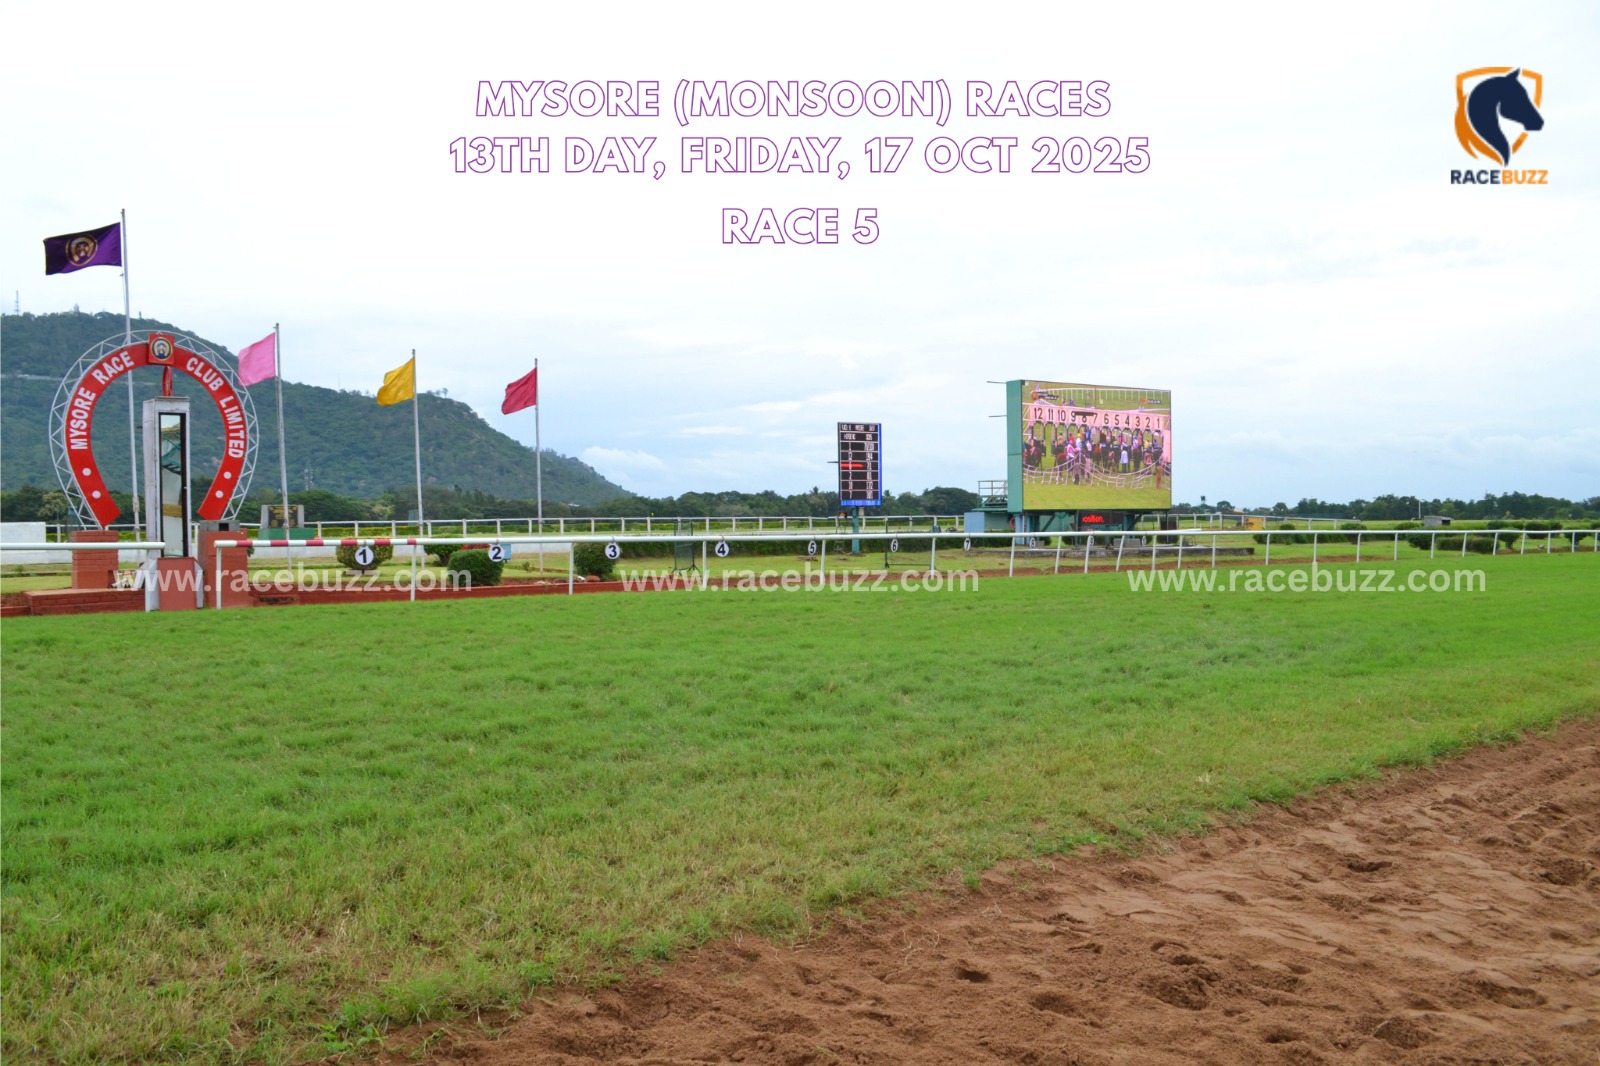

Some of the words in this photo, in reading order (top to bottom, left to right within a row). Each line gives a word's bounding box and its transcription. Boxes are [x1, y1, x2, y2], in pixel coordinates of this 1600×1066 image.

[69, 386, 96, 450] MYSORE
[92, 351, 135, 385] RACE
[186, 357, 224, 391] CLUB
[219, 395, 245, 459] LIMITED
[1034, 407, 1043, 420] 12
[1048, 409, 1054, 420] 11
[1058, 410, 1066, 421] 10
[1071, 411, 1076, 422] 9
[1103, 413, 1110, 425] 6
[1114, 414, 1120, 426] 5
[1124, 415, 1130, 427] 4
[1135, 416, 1141, 427] 3
[1145, 417, 1151, 428] 2
[1156, 417, 1160, 428] 1
[492, 546, 501, 559] 2
[608, 544, 617, 558] 3
[717, 543, 726, 556] 4
[809, 542, 815, 554] 5
[358, 549, 368, 564] 1
